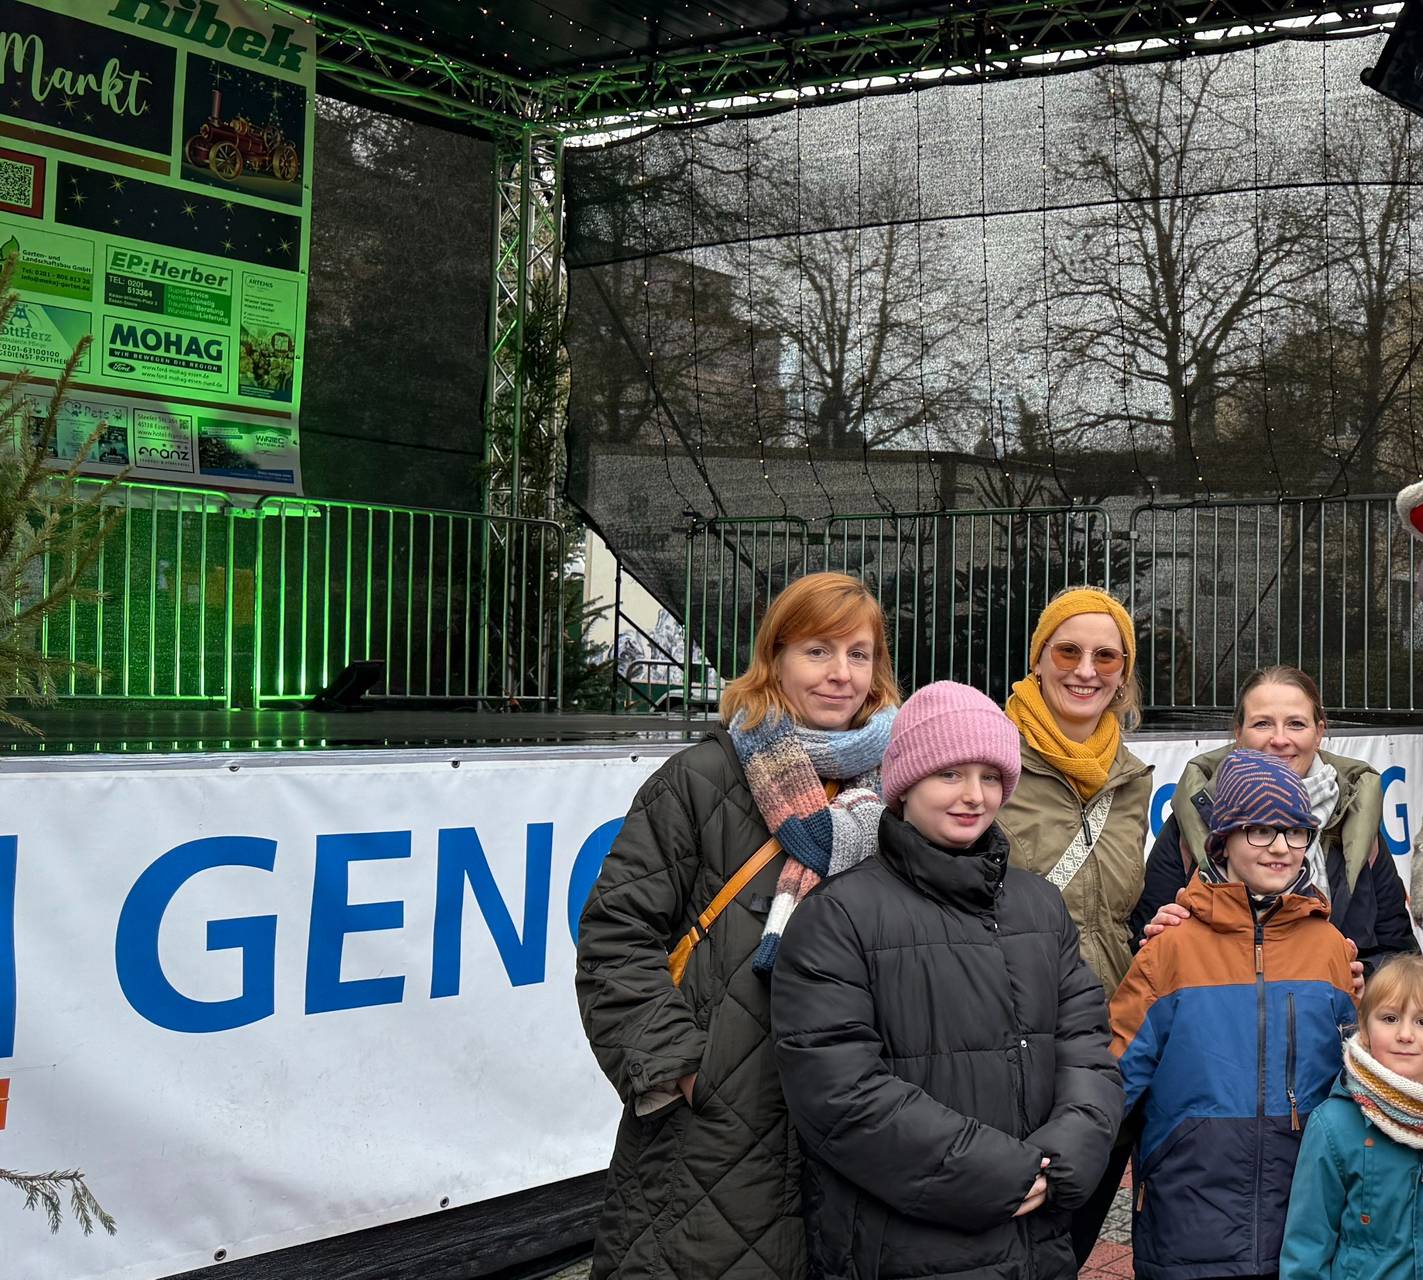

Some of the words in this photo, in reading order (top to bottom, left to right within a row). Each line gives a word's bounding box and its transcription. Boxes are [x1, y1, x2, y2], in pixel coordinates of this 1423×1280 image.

[0, 31, 153, 116] Markt
[0, 325, 52, 342] ottHerz
[109, 323, 223, 362] MOHAG
